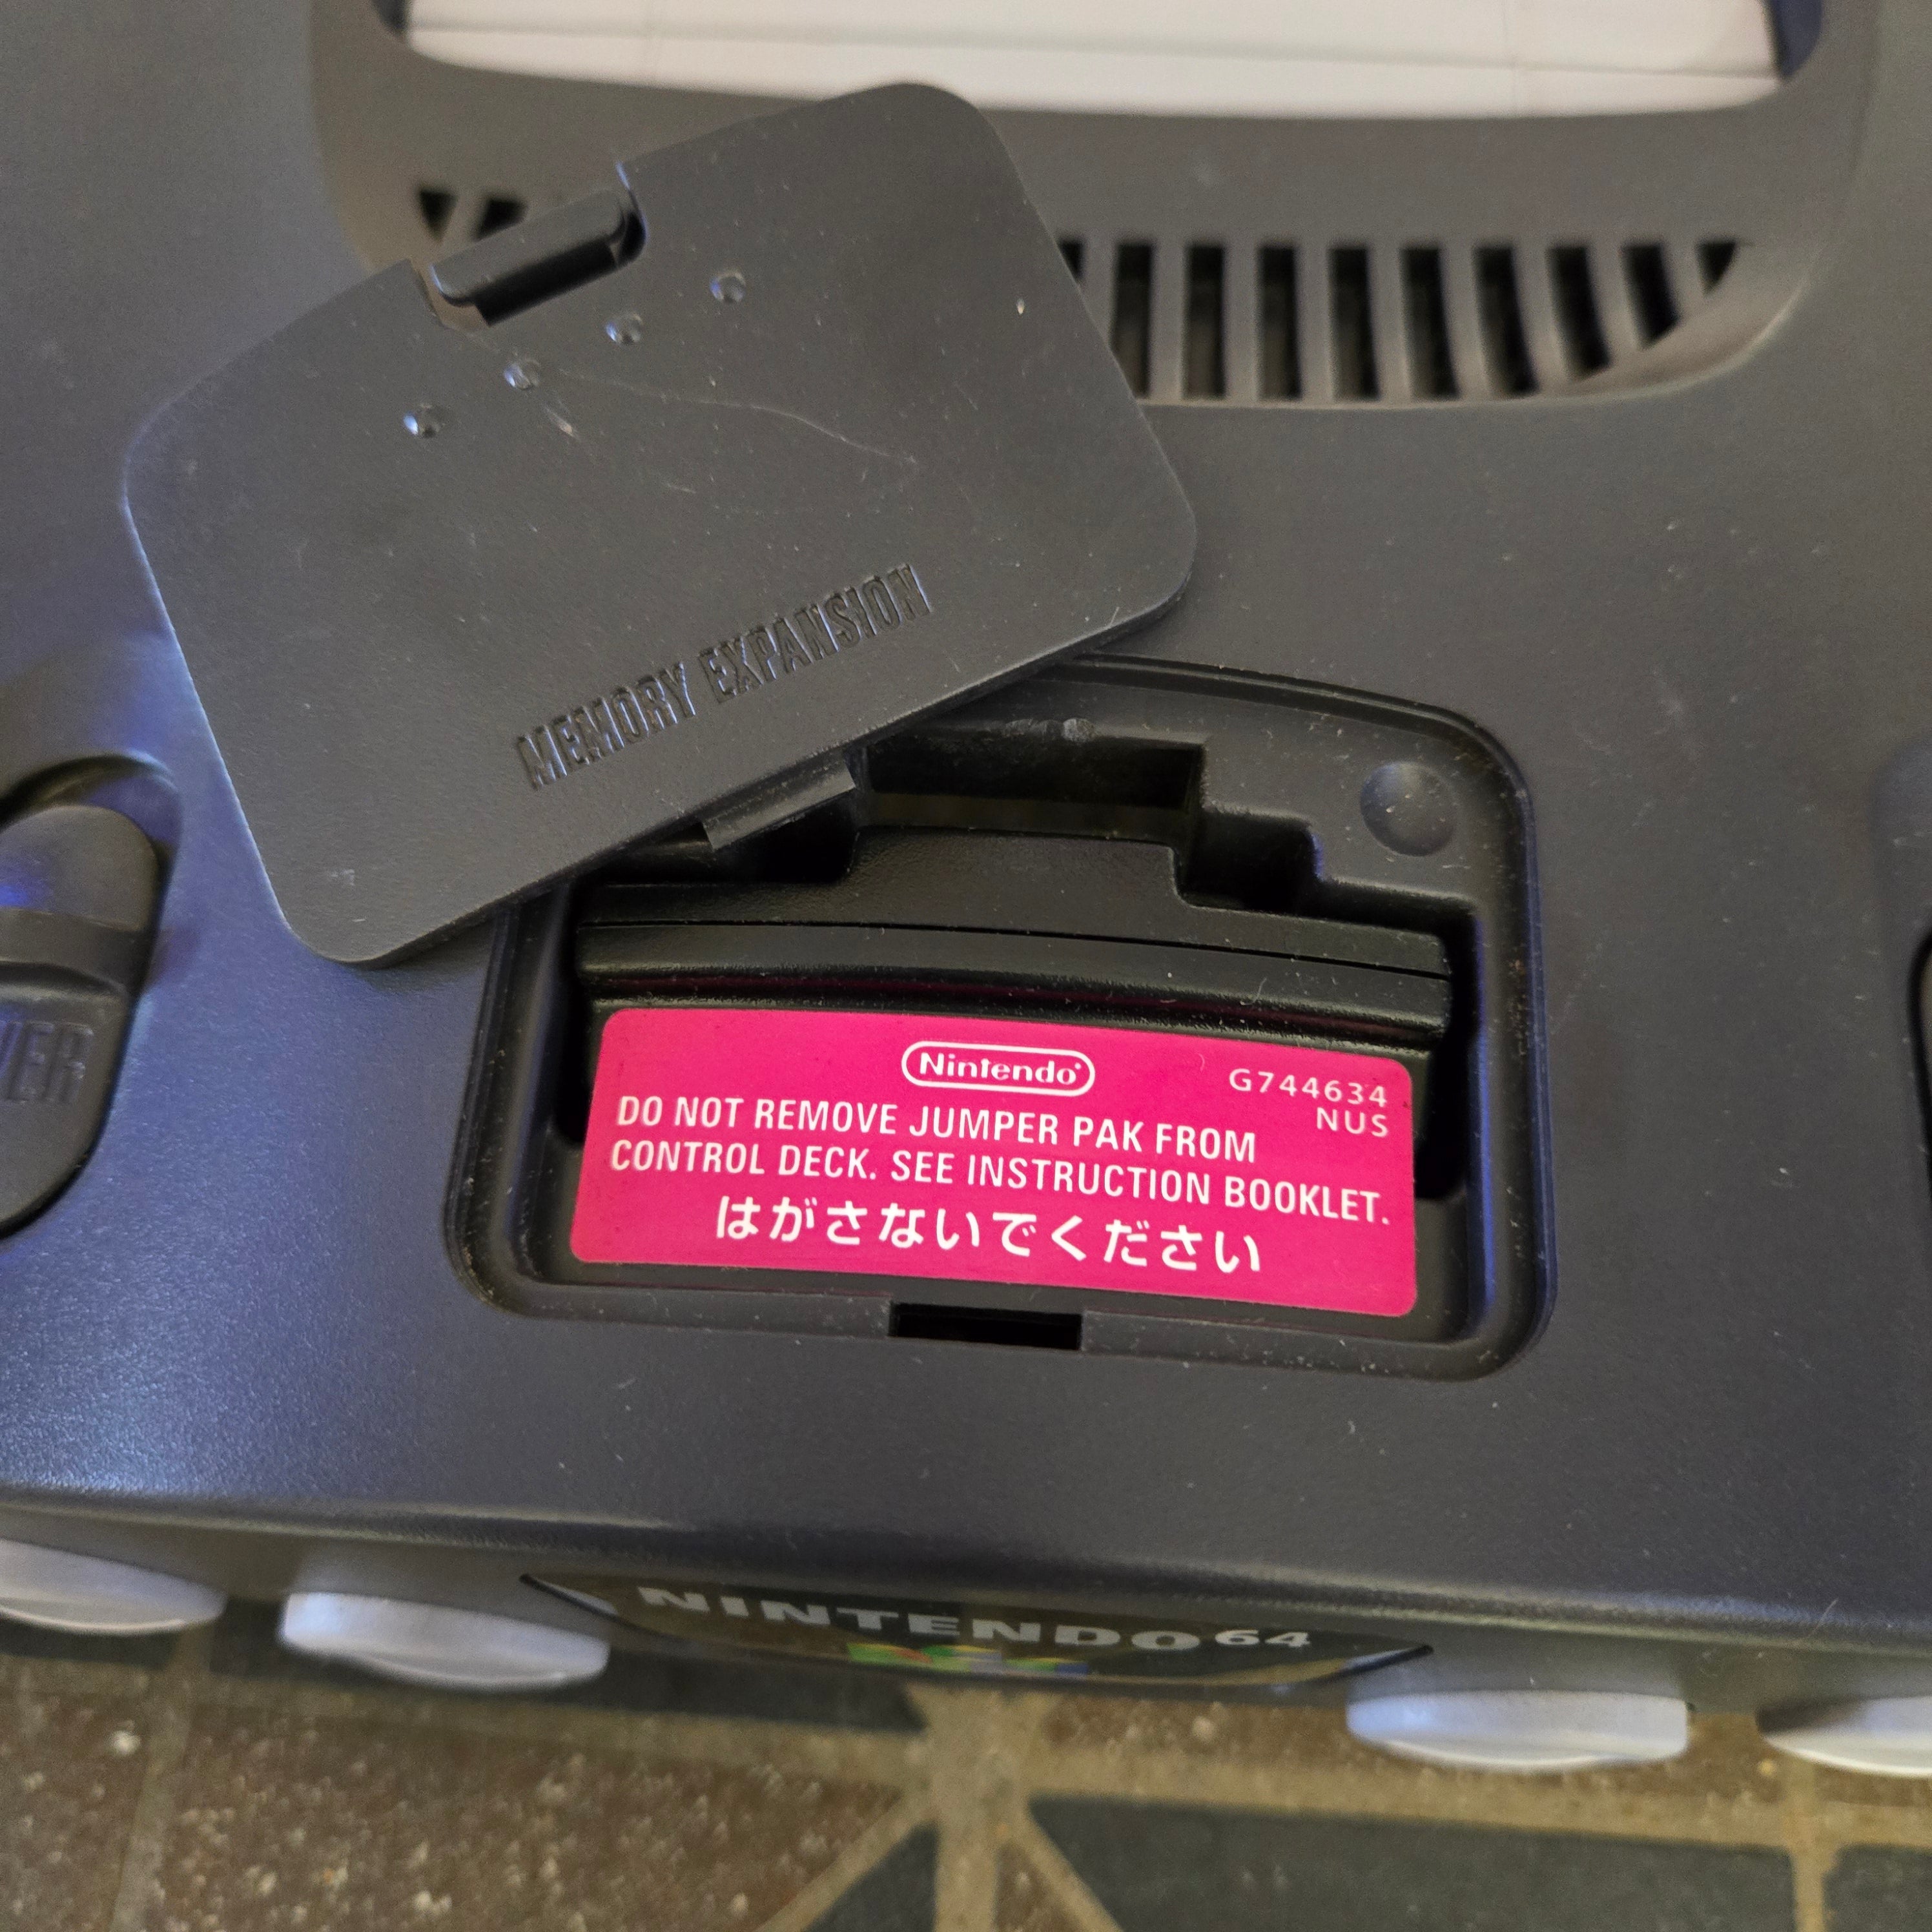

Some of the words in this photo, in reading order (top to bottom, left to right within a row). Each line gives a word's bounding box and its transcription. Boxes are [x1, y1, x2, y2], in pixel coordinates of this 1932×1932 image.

[517, 663, 695, 790] MEMORY
[698, 563, 932, 704] EXPANSION
[919, 1051, 1077, 1085] Nintendo
[1228, 1067, 1387, 1108] G744634
[617, 1095, 663, 1127] DO
[673, 1096, 745, 1129] NOT
[754, 1098, 898, 1135] REMOVE
[909, 1105, 1059, 1146] JUMPER
[1073, 1115, 1144, 1153] PAK
[1155, 1122, 1256, 1164] FROM
[1316, 1106, 1389, 1138] NUS
[611, 1138, 766, 1175] CONTROL
[777, 1144, 877, 1180] DECK.
[890, 1149, 955, 1184] SEE
[967, 1154, 1211, 1205] INSTRUCTION
[1224, 1175, 1390, 1225] BOOKLET.
[715, 1195, 1261, 1274] はがさないでください
[637, 1586, 1201, 1651] NINTENDO
[1213, 1629, 1312, 1648] 64
